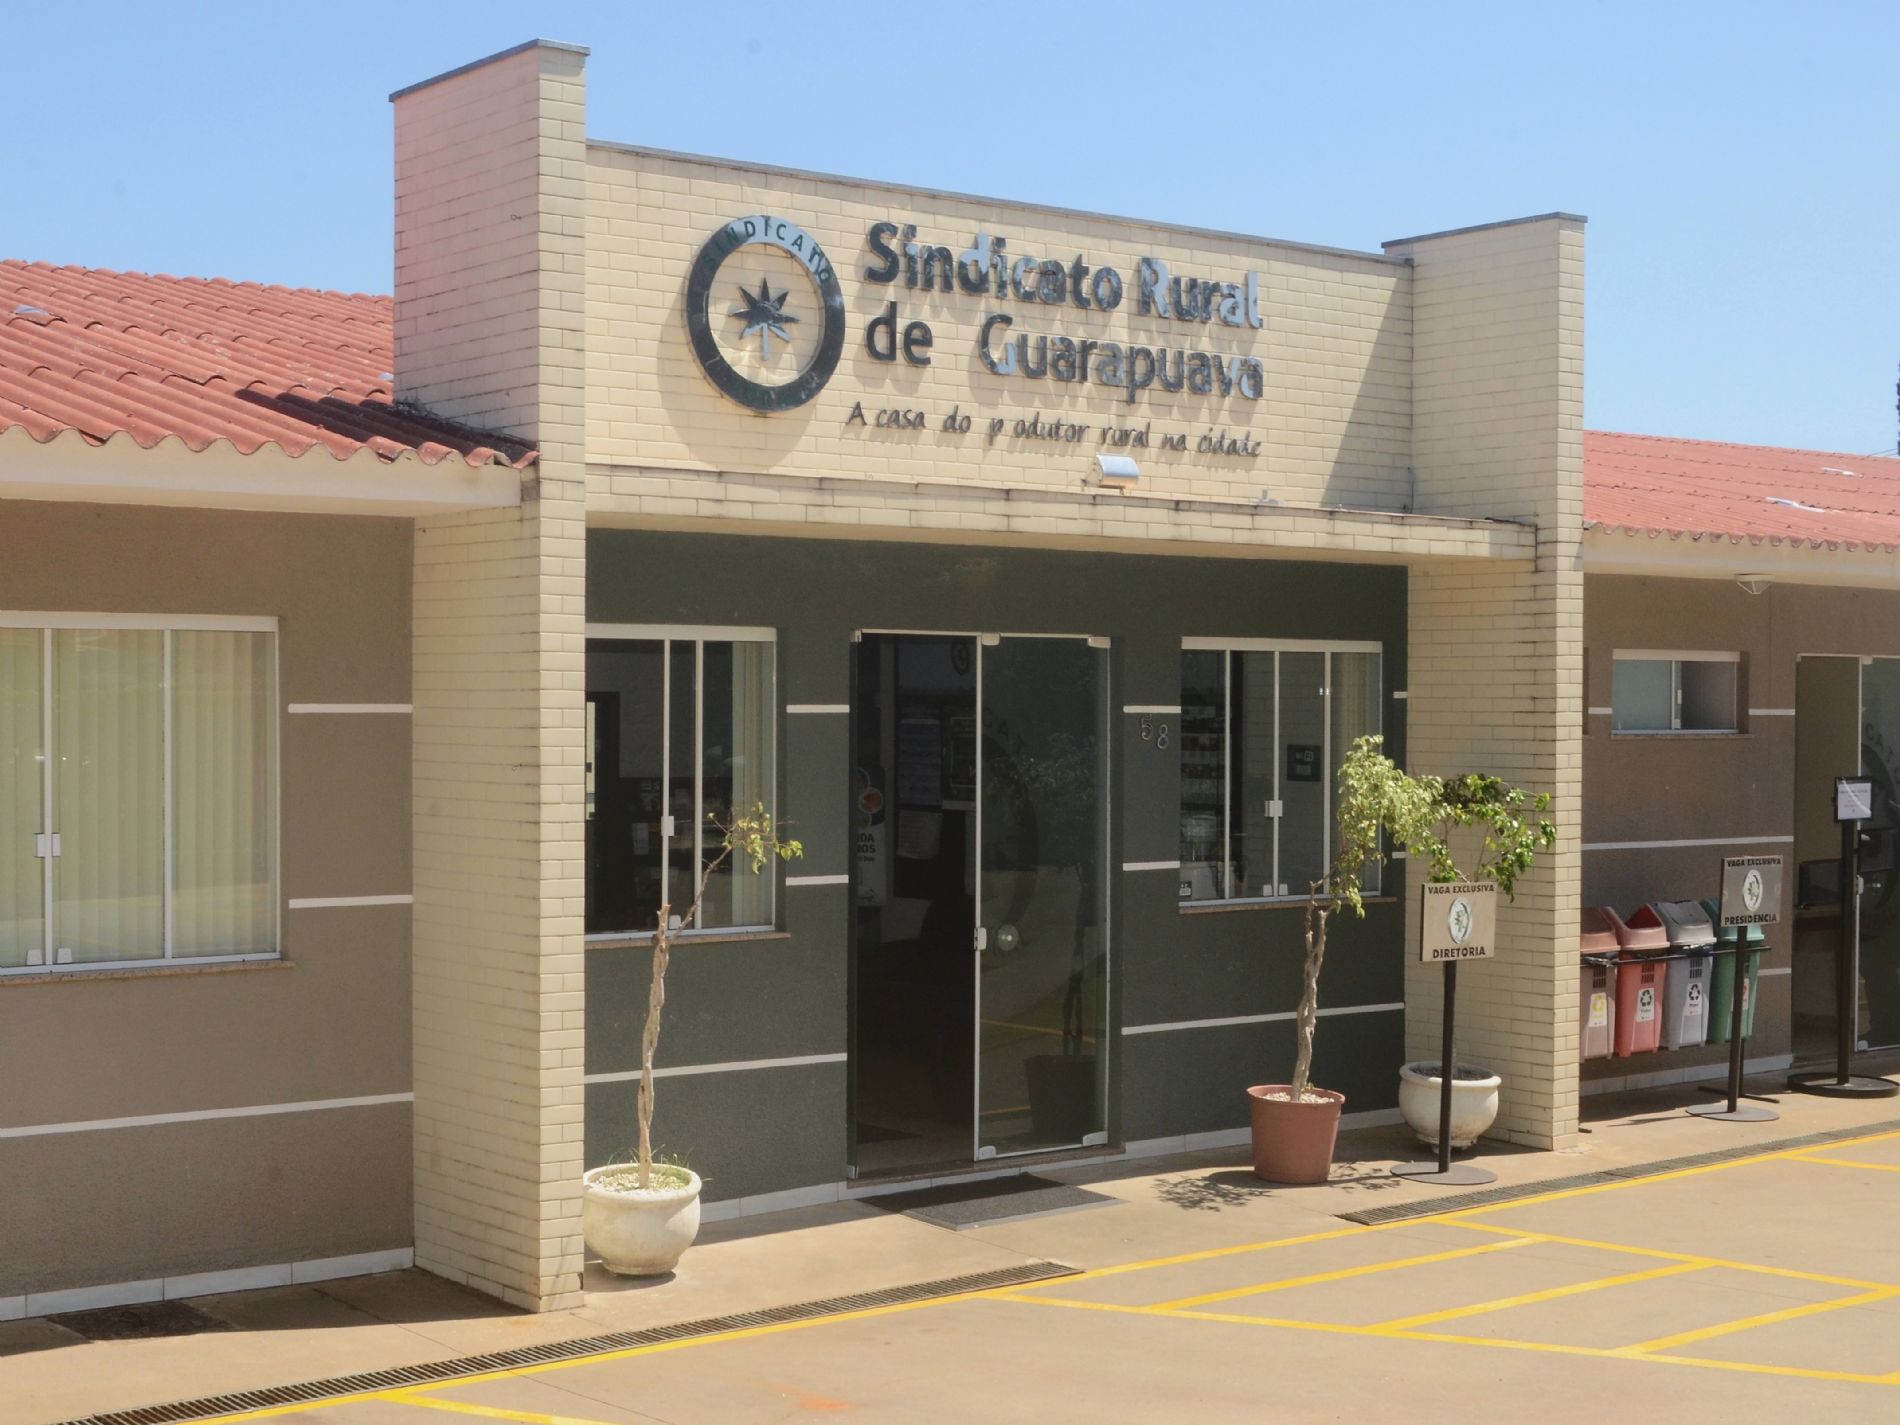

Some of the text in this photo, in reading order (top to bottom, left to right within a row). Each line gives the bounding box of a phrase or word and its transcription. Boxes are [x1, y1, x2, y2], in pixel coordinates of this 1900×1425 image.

[864, 222, 1264, 328] Sindicato Rural
[866, 301, 1264, 405] de Guarapuava
[846, 401, 867, 427] A
[875, 408, 926, 429] casa
[942, 404, 972, 434] do
[1101, 421, 1150, 448] rural
[1161, 433, 1187, 451] na
[1197, 427, 1262, 457] cidade
[1727, 859, 1745, 867] VAGA
[1428, 884, 1494, 894] VAGA EXCLUSIVA
[1432, 946, 1486, 958] DIRETORIA
